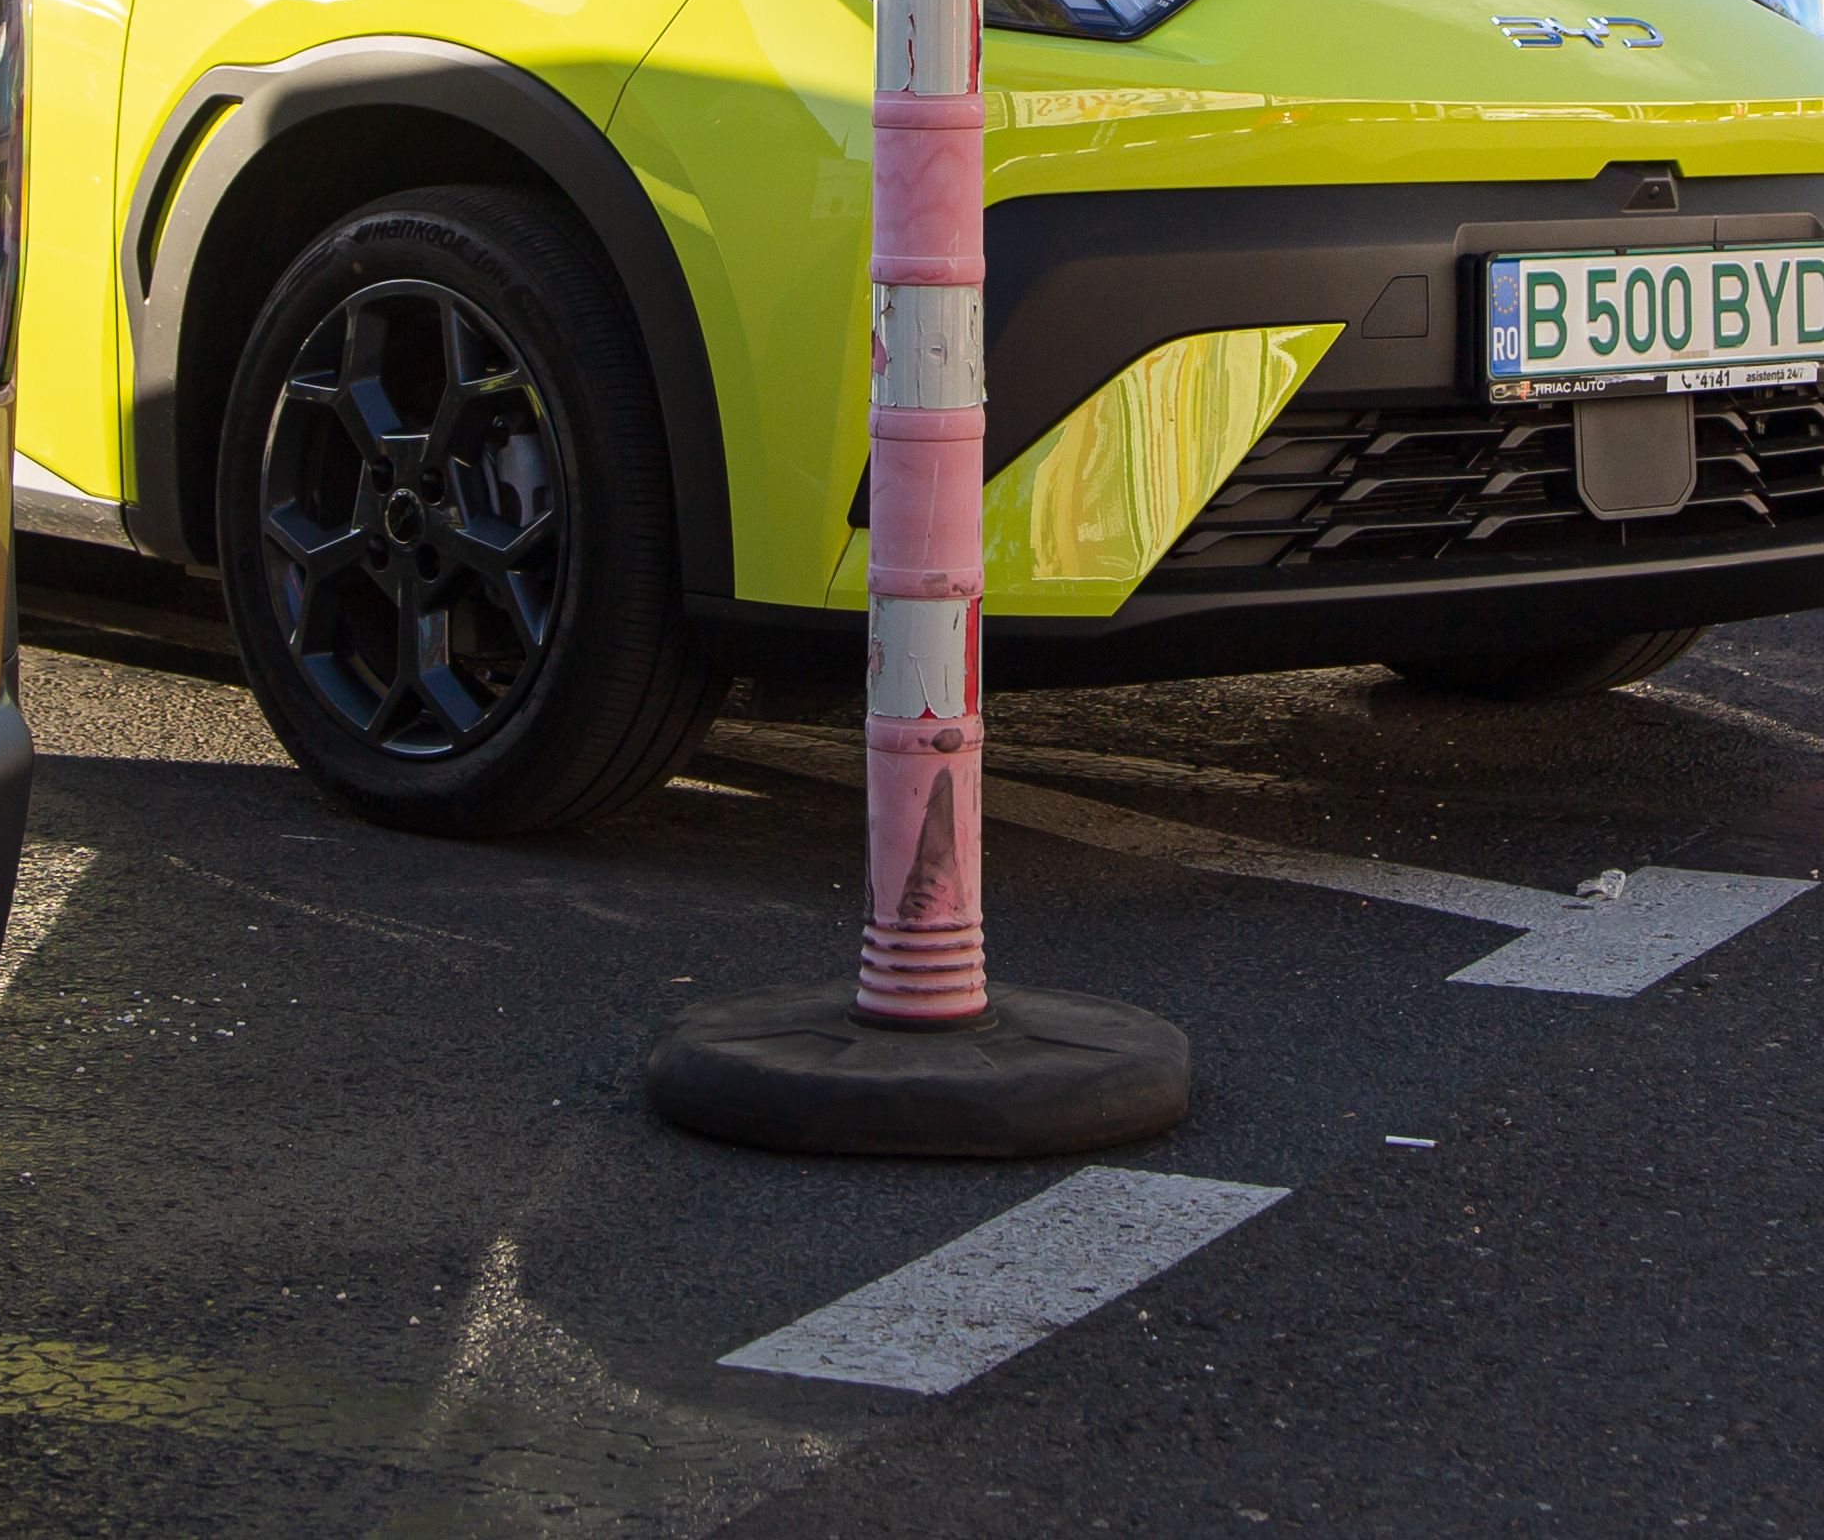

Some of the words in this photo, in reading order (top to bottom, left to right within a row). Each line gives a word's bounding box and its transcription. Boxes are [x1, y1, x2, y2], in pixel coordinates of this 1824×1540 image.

[1490, 14, 1666, 50] BYD
[1525, 271, 1568, 360] B
[1586, 265, 1692, 356] 500
[1492, 325, 1519, 360] RO
[1573, 379, 1606, 393] AUTO
